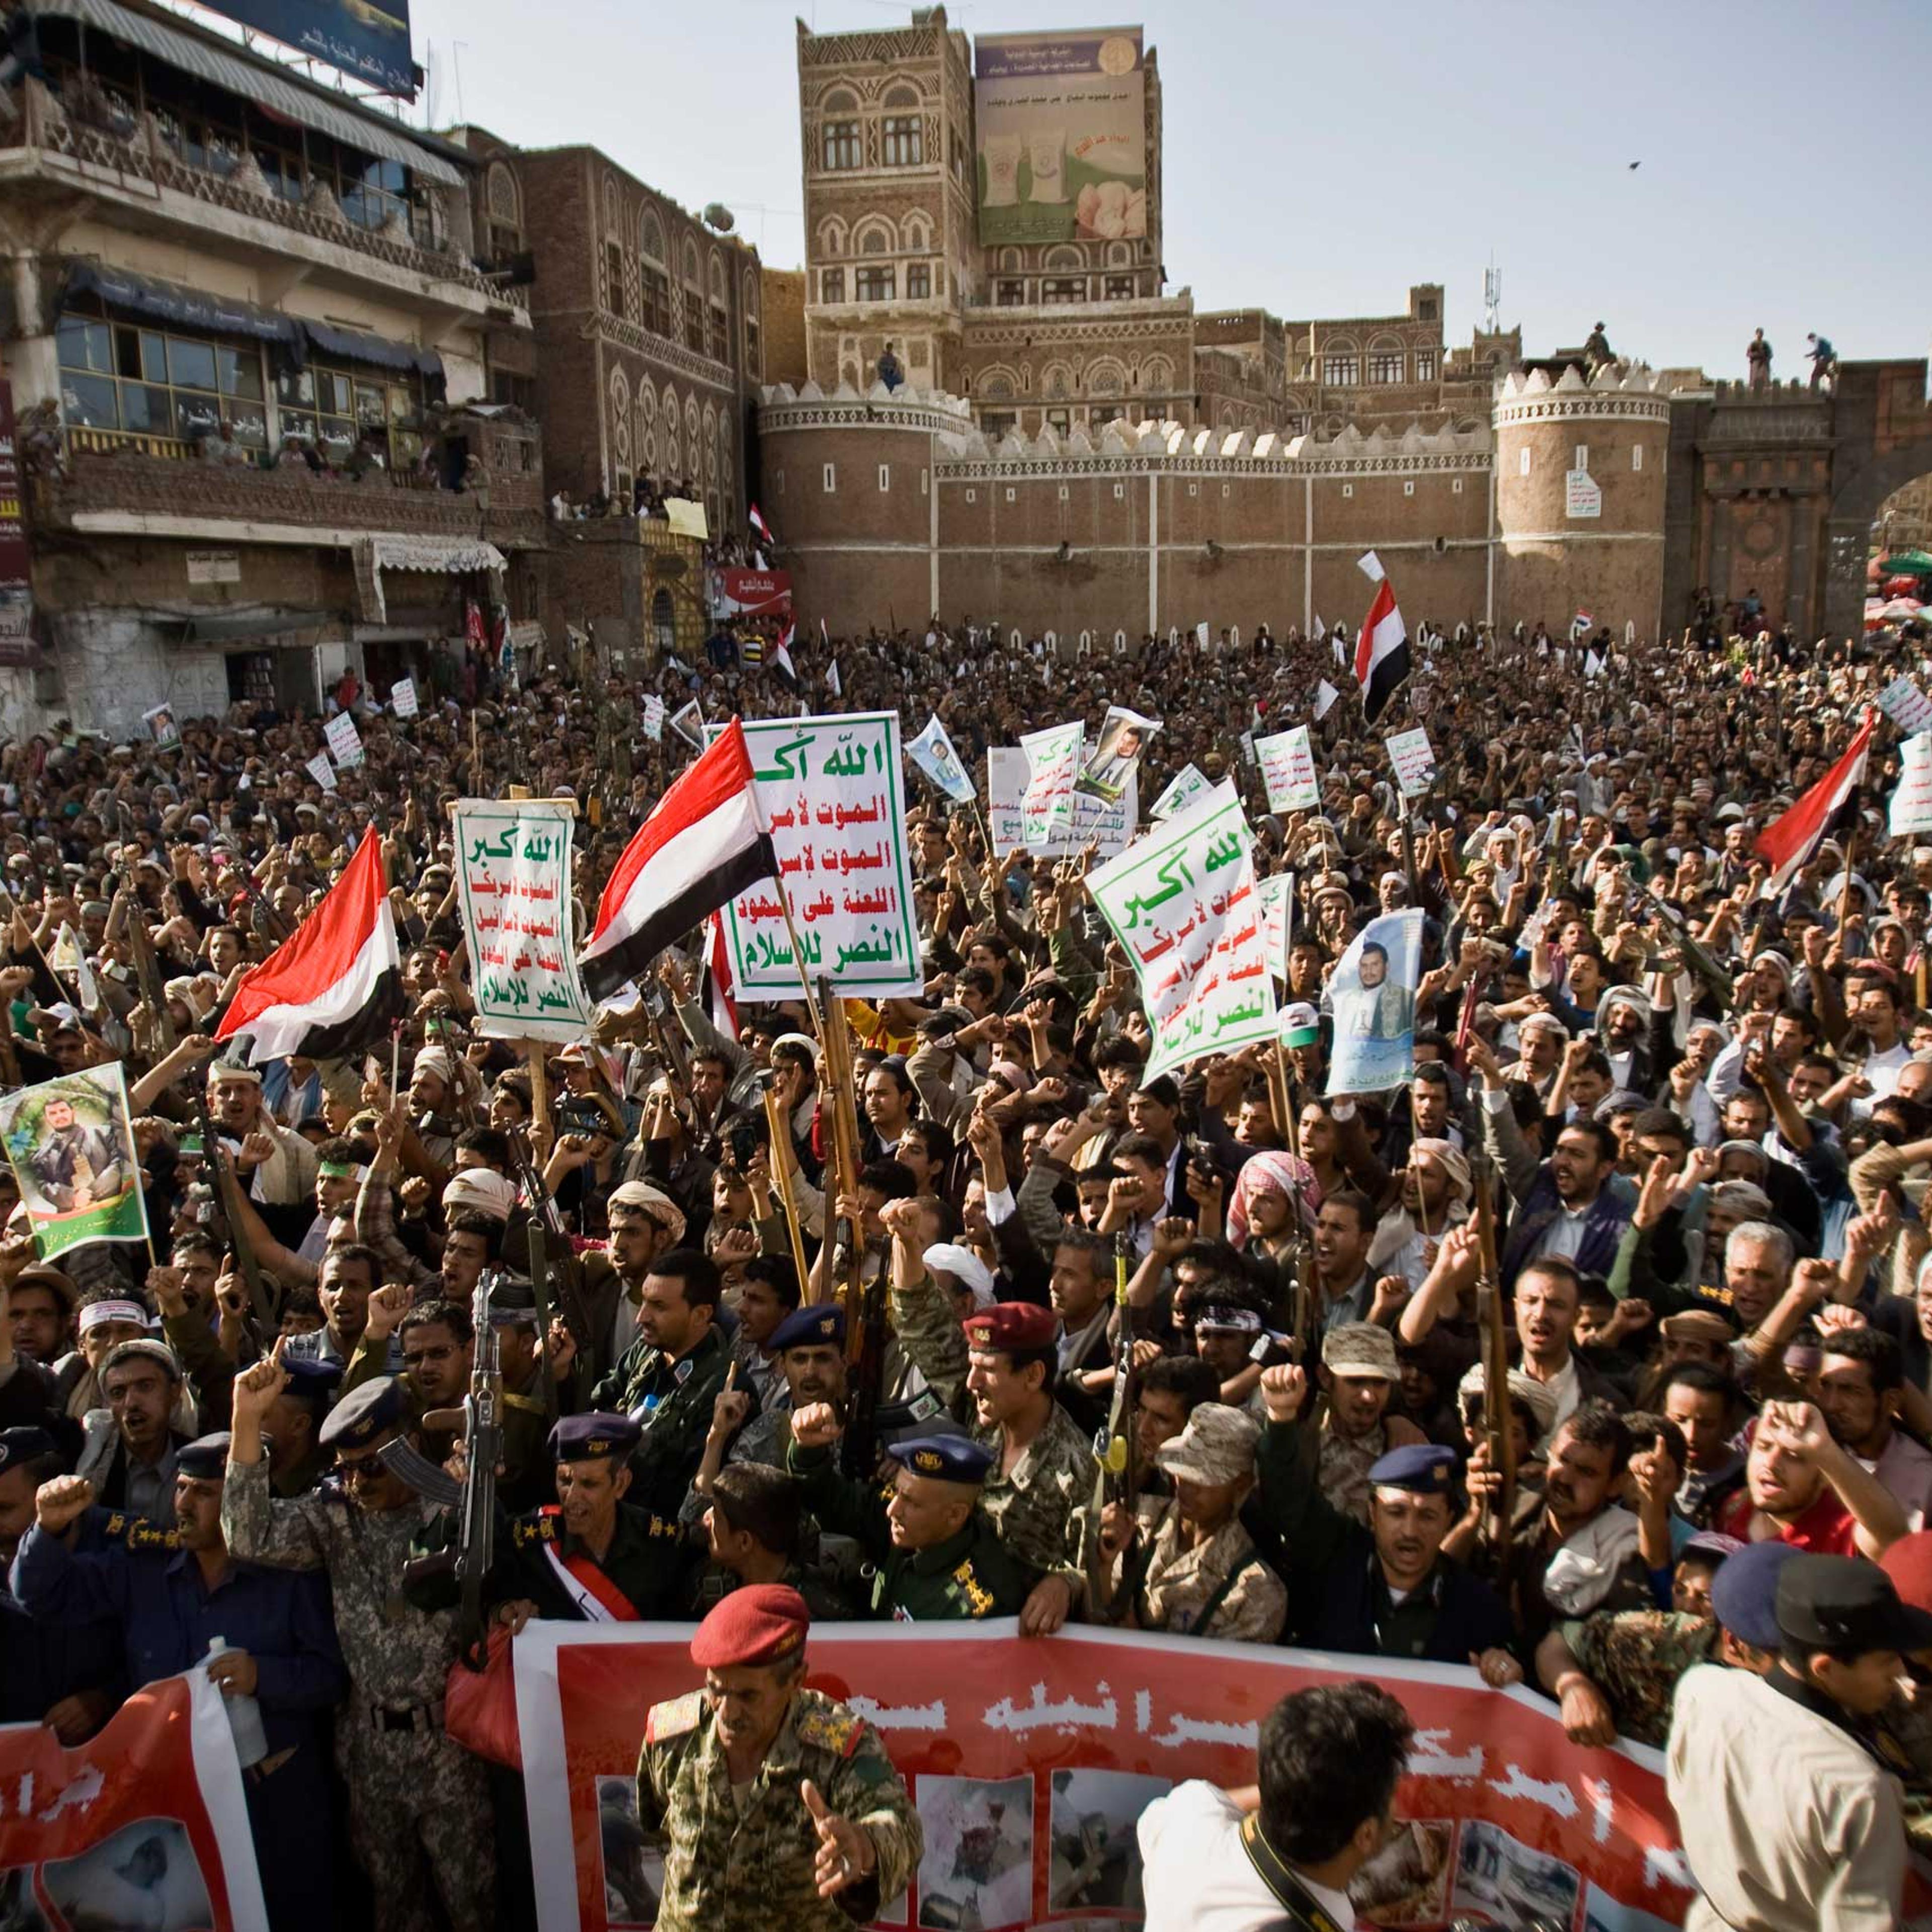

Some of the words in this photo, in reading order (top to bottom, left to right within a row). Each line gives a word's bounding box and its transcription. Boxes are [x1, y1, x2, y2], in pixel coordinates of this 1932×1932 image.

[755, 730, 816, 781] أك
[769, 791, 809, 834] لأمر
[817, 793, 886, 830] الموت
[780, 843, 815, 878] لإسر
[822, 840, 891, 876] الموت
[738, 890, 794, 924] ايهود
[803, 889, 835, 922] على
[844, 884, 896, 914] اللعنة
[512, 948, 531, 972] على
[832, 923, 903, 974] النصر
[536, 979, 576, 1012] النصر
